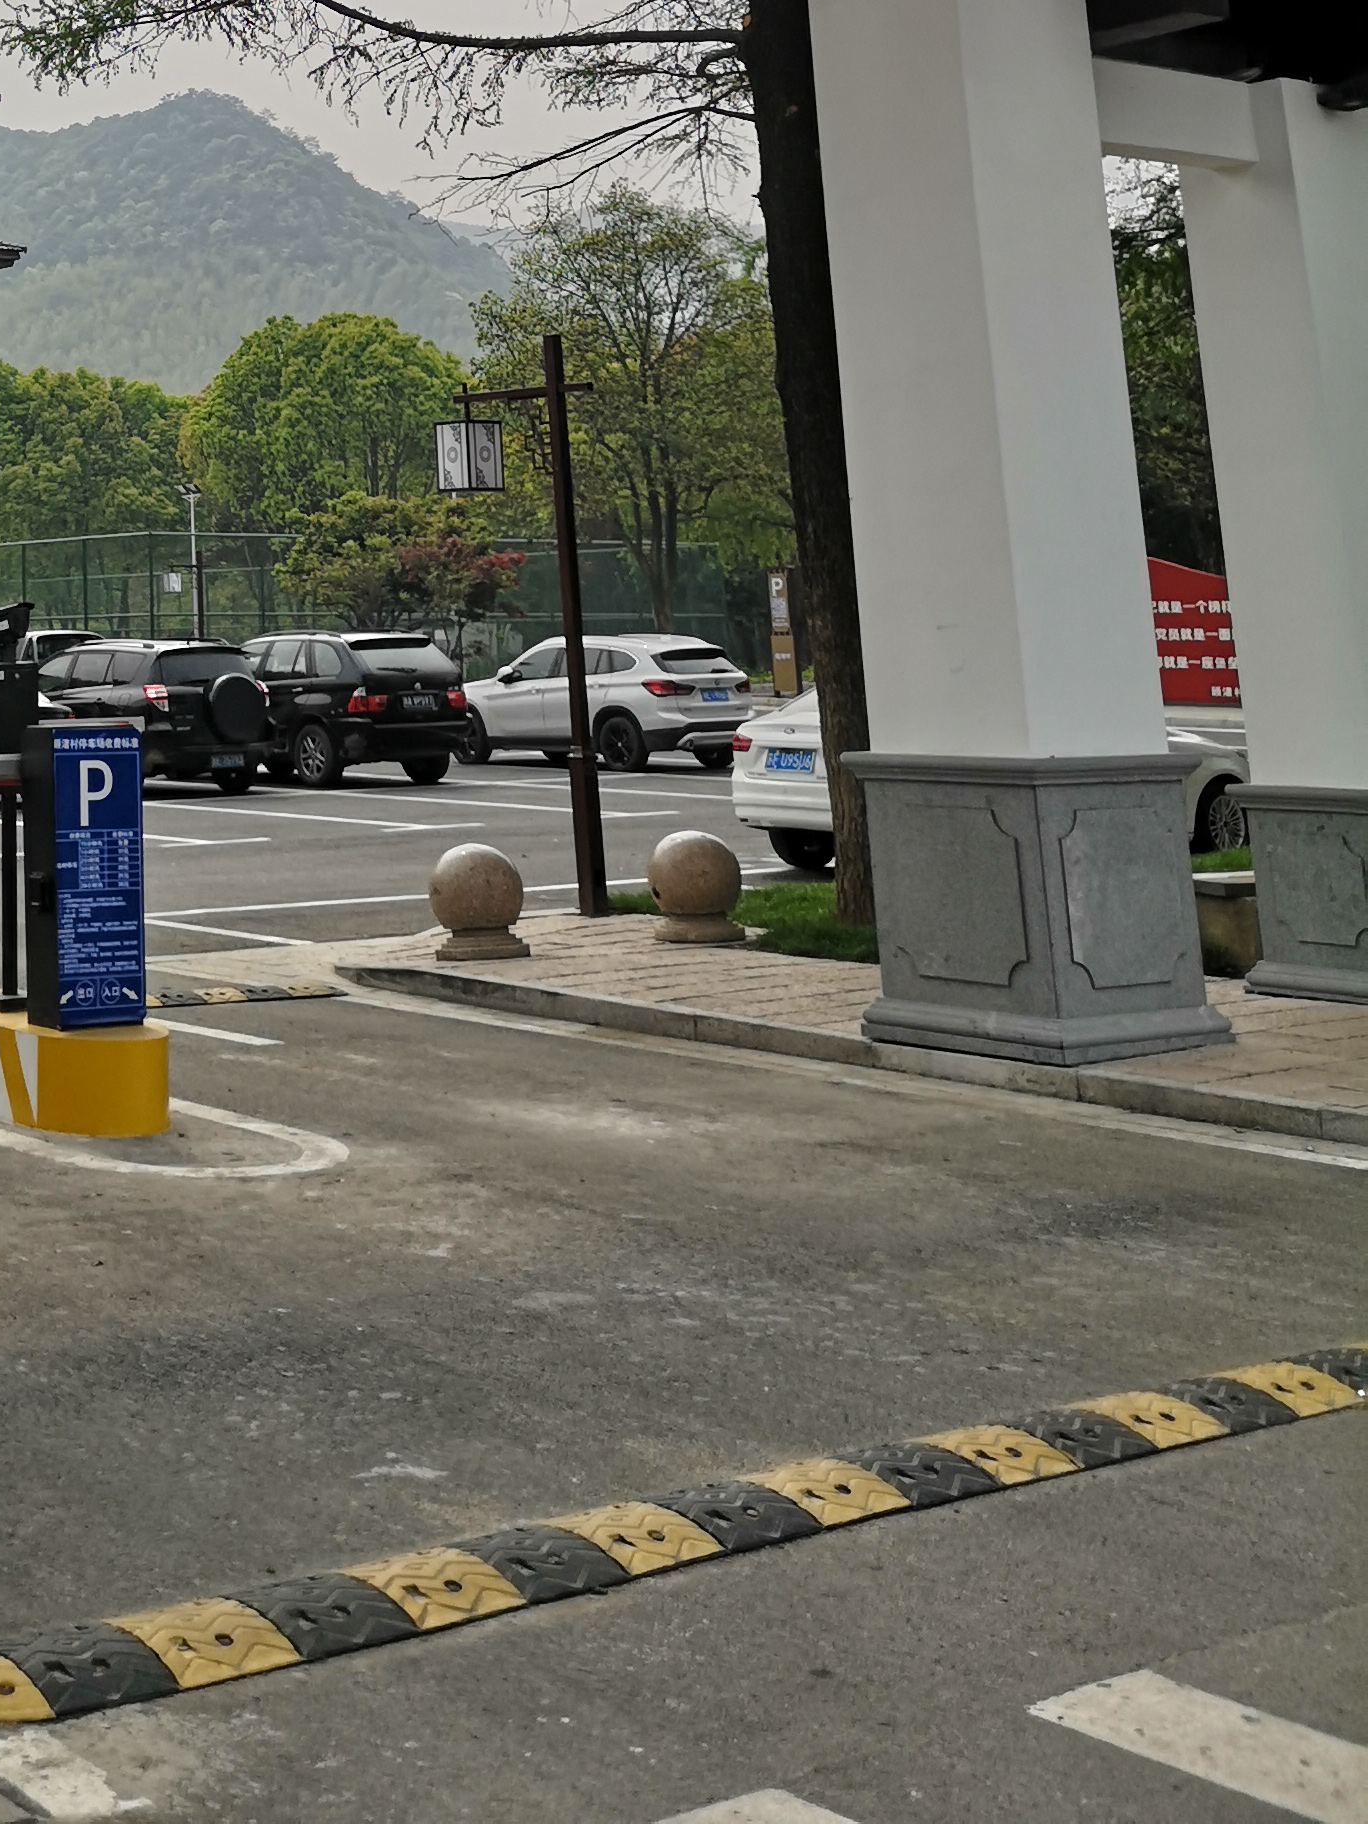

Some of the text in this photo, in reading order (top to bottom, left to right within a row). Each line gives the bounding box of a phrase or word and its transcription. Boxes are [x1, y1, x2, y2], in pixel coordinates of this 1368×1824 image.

[771, 577, 783, 597] P
[1155, 627, 1232, 641] 党员就是一面
[79, 759, 114, 827] P
[103, 986, 120, 997] 入口
